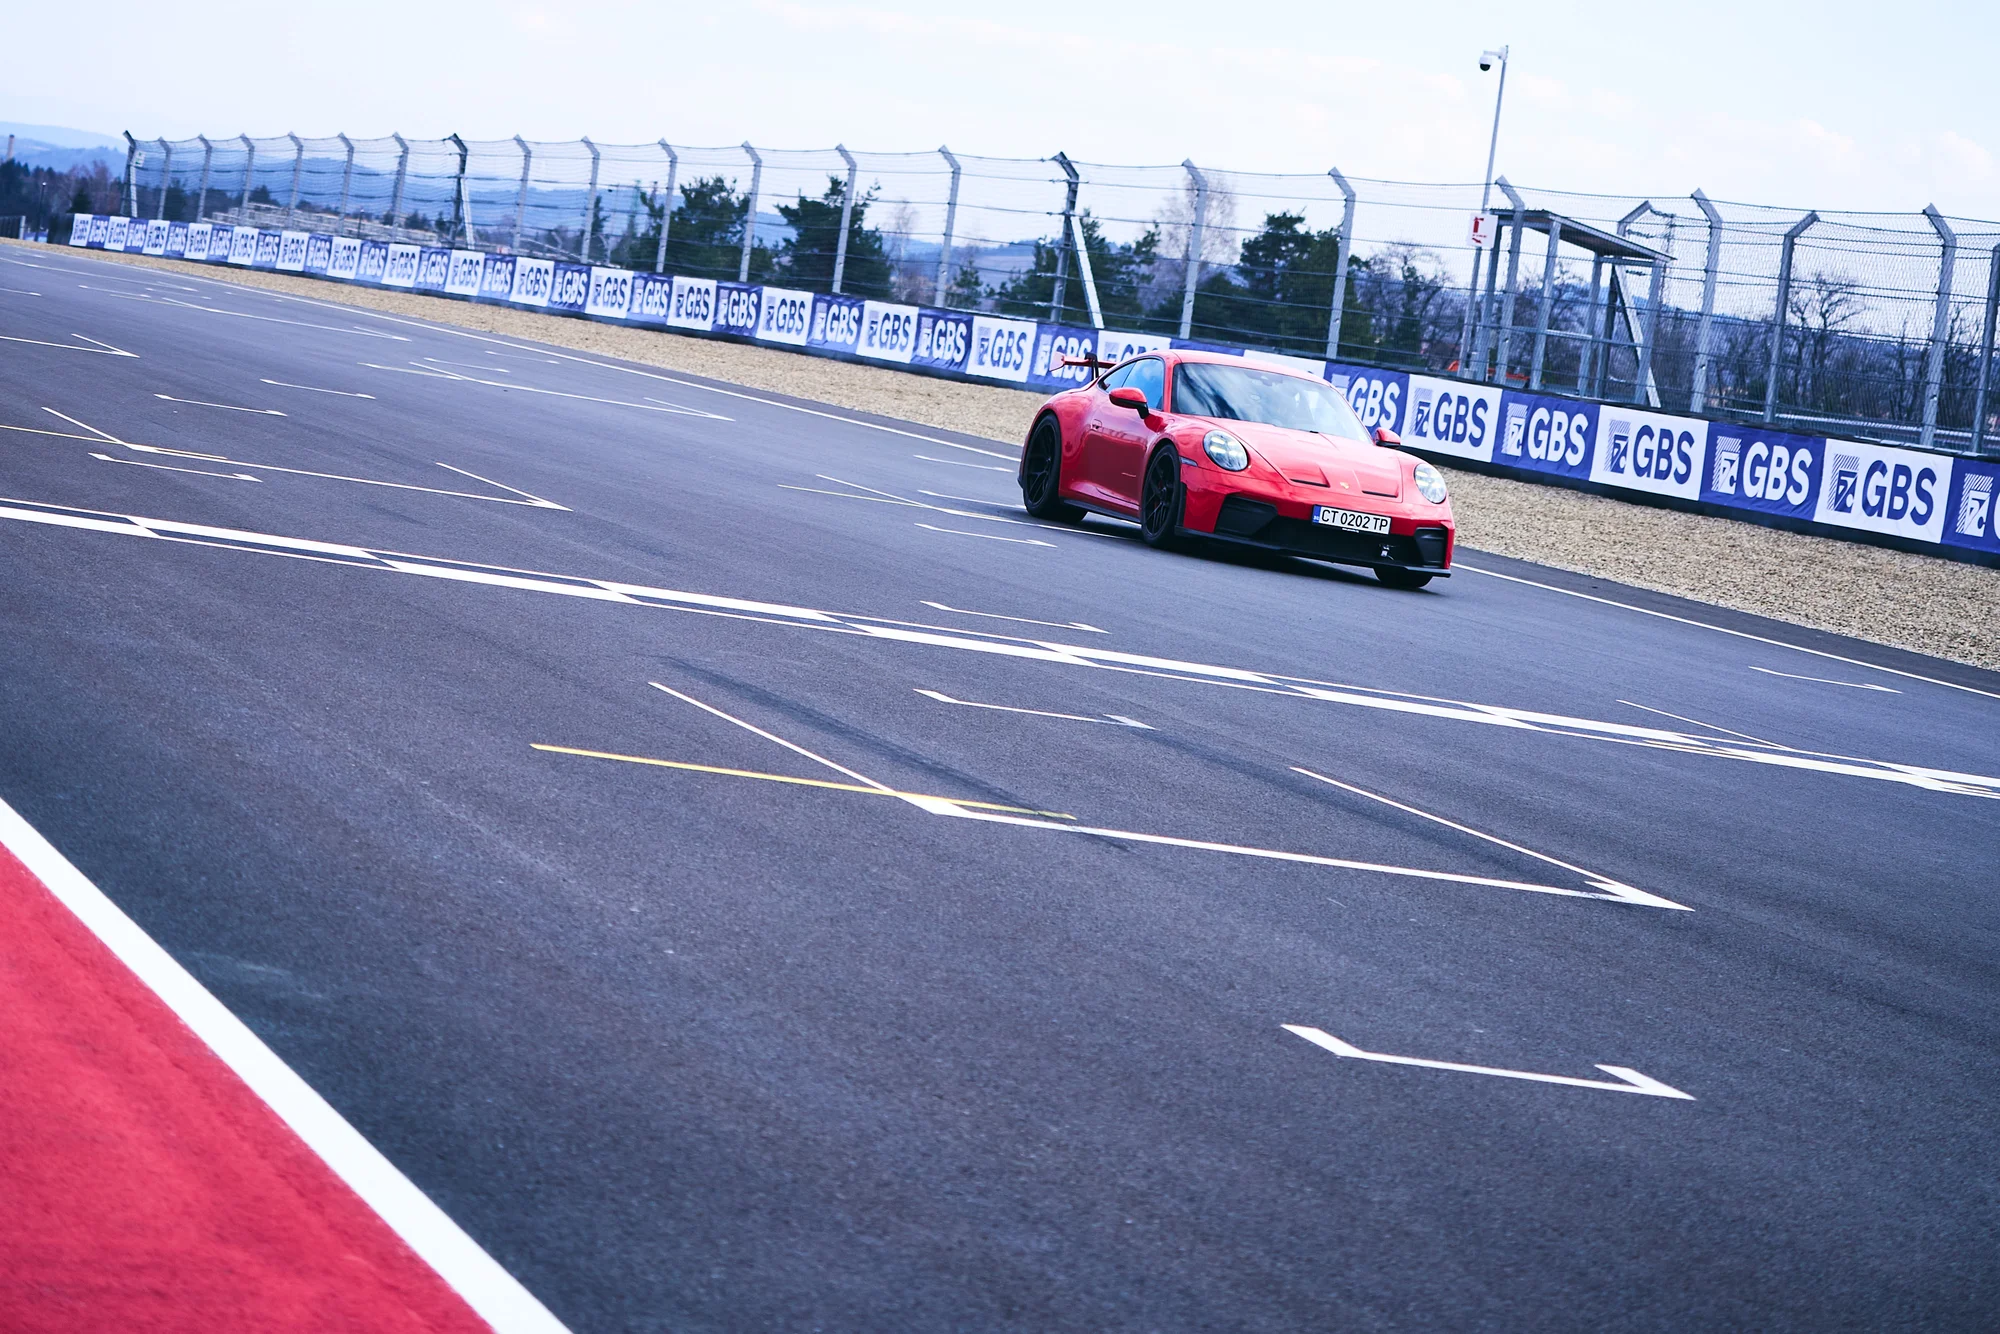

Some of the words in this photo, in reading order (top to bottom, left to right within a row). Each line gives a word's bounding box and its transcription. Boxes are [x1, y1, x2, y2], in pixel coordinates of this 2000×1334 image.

[288, 238, 305, 264] GBS
[312, 240, 330, 268] GBS
[340, 245, 357, 272] GBS
[366, 247, 386, 277] GBS
[396, 251, 415, 280] GBS
[426, 253, 448, 284] GBS
[459, 258, 480, 288] GBS
[491, 261, 512, 293] GBS
[525, 266, 549, 298] GBS
[562, 271, 587, 305] GBS
[603, 276, 628, 310] GBS
[643, 280, 669, 317] GBS
[684, 285, 710, 321] GBS
[728, 290, 758, 328] GBS
[776, 298, 806, 335] GBS
[825, 304, 859, 345] GBS
[879, 312, 912, 352] GBS
[932, 319, 967, 362] GBS
[990, 329, 1027, 371] GBS
[1433, 392, 1488, 447] GBS
[1527, 407, 1589, 466] GBS
[1632, 424, 1695, 484] GBS
[1742, 441, 1813, 505] GBS
[1861, 460, 1937, 525] GBS
[1321, 509, 1339, 523] CT
[1340, 512, 1370, 529] 0202
[1373, 517, 1388, 531] TP
